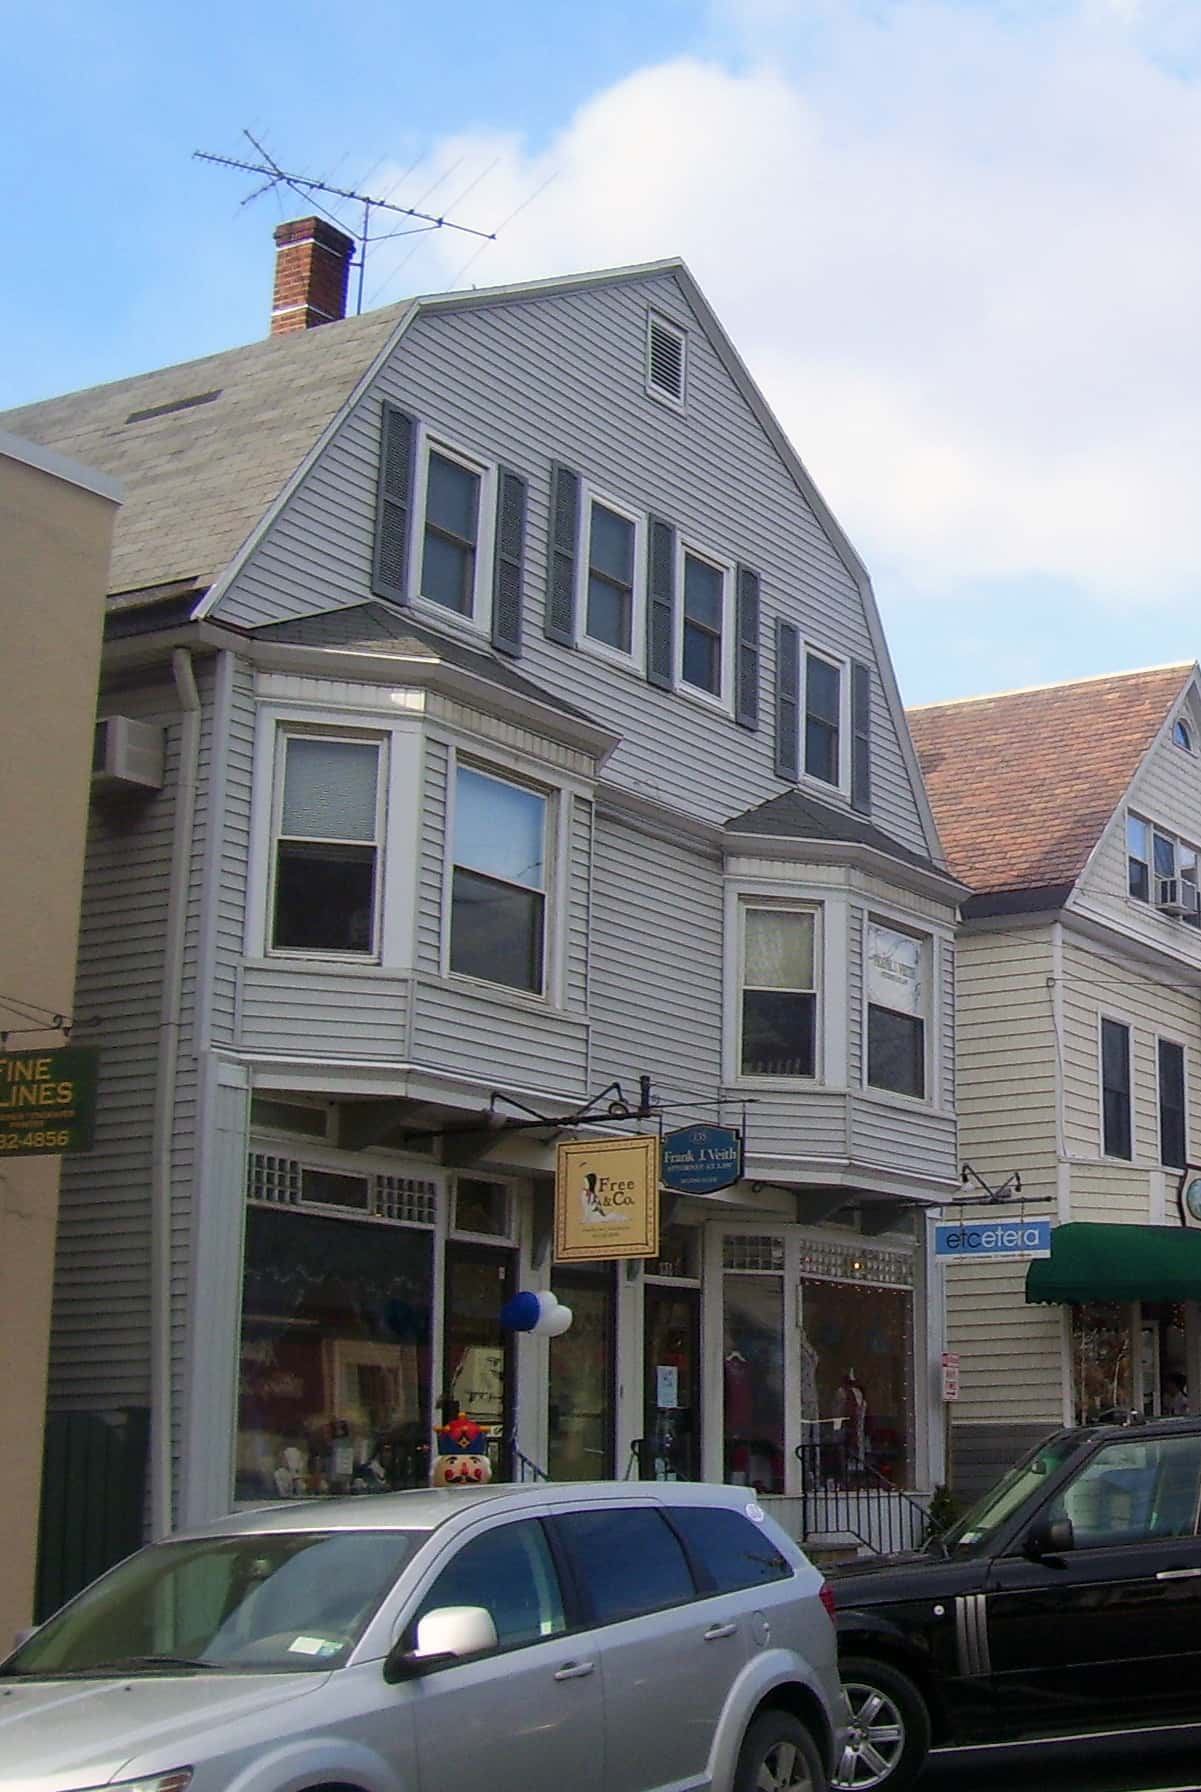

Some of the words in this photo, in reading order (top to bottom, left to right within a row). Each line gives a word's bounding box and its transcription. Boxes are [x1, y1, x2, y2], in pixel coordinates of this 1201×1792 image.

[664, 1149, 695, 1163] Frank
[708, 1147, 737, 1160] Veith
[599, 1177, 635, 1192] Free
[945, 1226, 1040, 1249] etcetera
